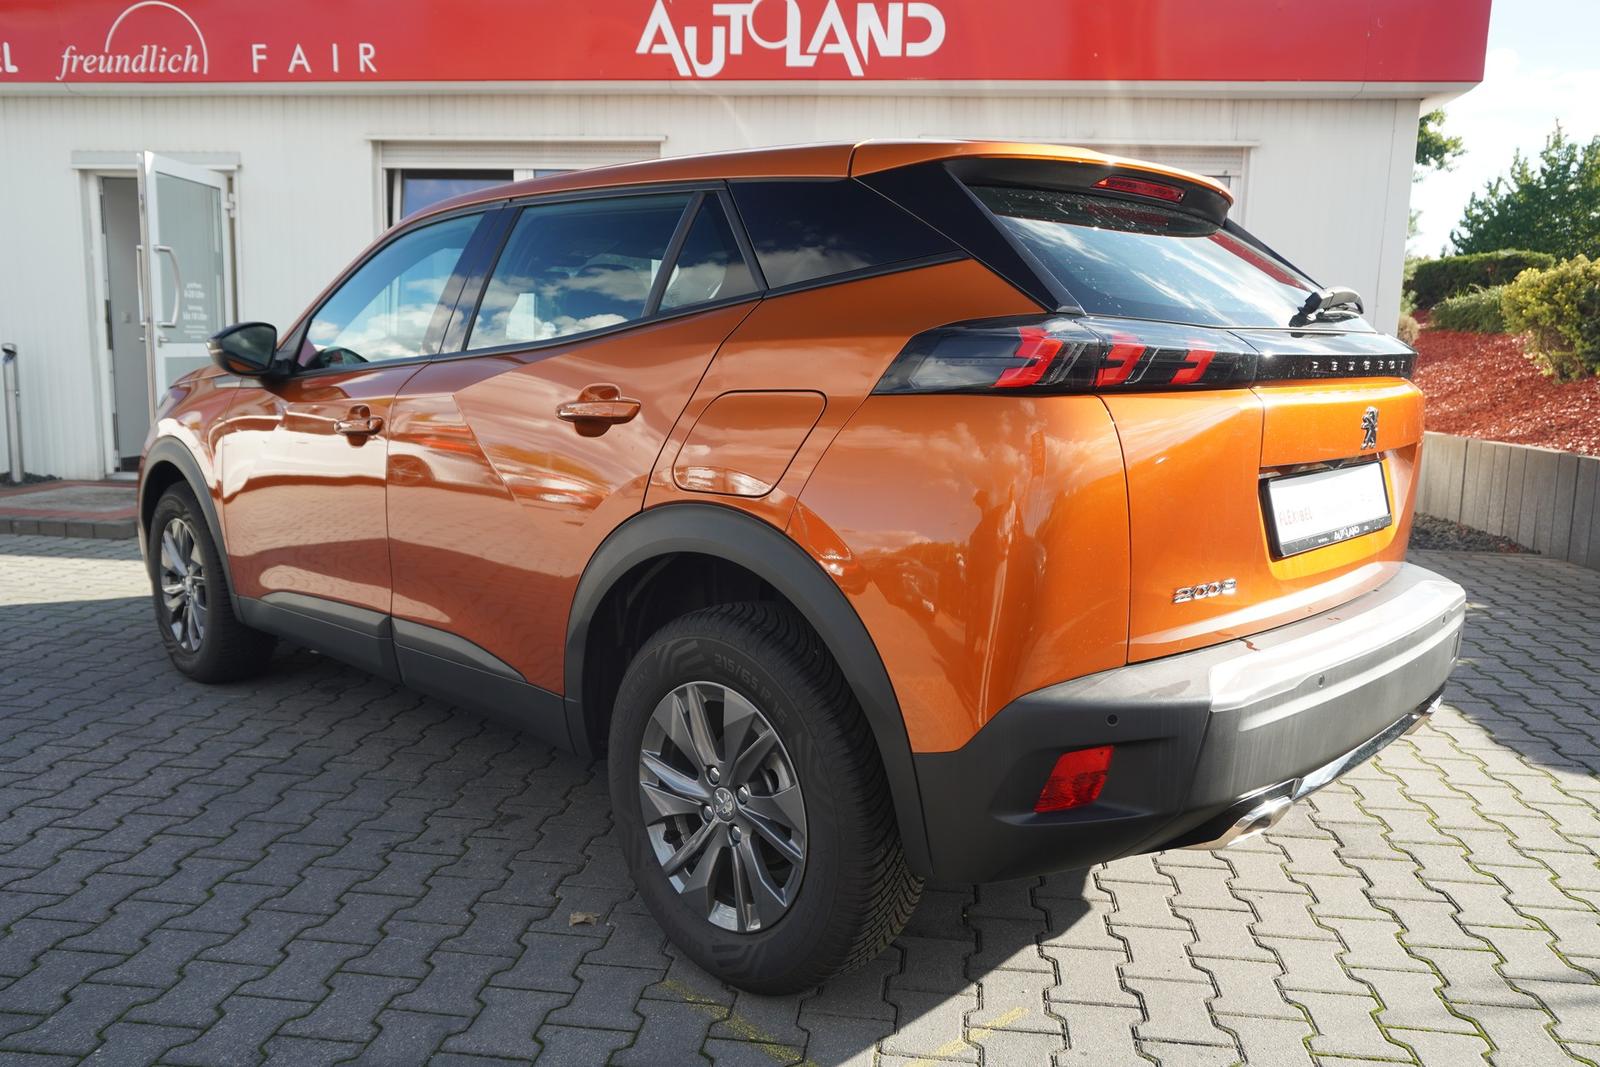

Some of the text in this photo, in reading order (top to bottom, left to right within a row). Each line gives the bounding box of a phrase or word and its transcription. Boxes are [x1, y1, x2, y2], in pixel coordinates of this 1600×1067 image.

[635, 0, 946, 77] AUTOLAND
[56, 44, 200, 80] freundlich
[251, 43, 378, 73] FAIR
[1173, 578, 1236, 604] 2008
